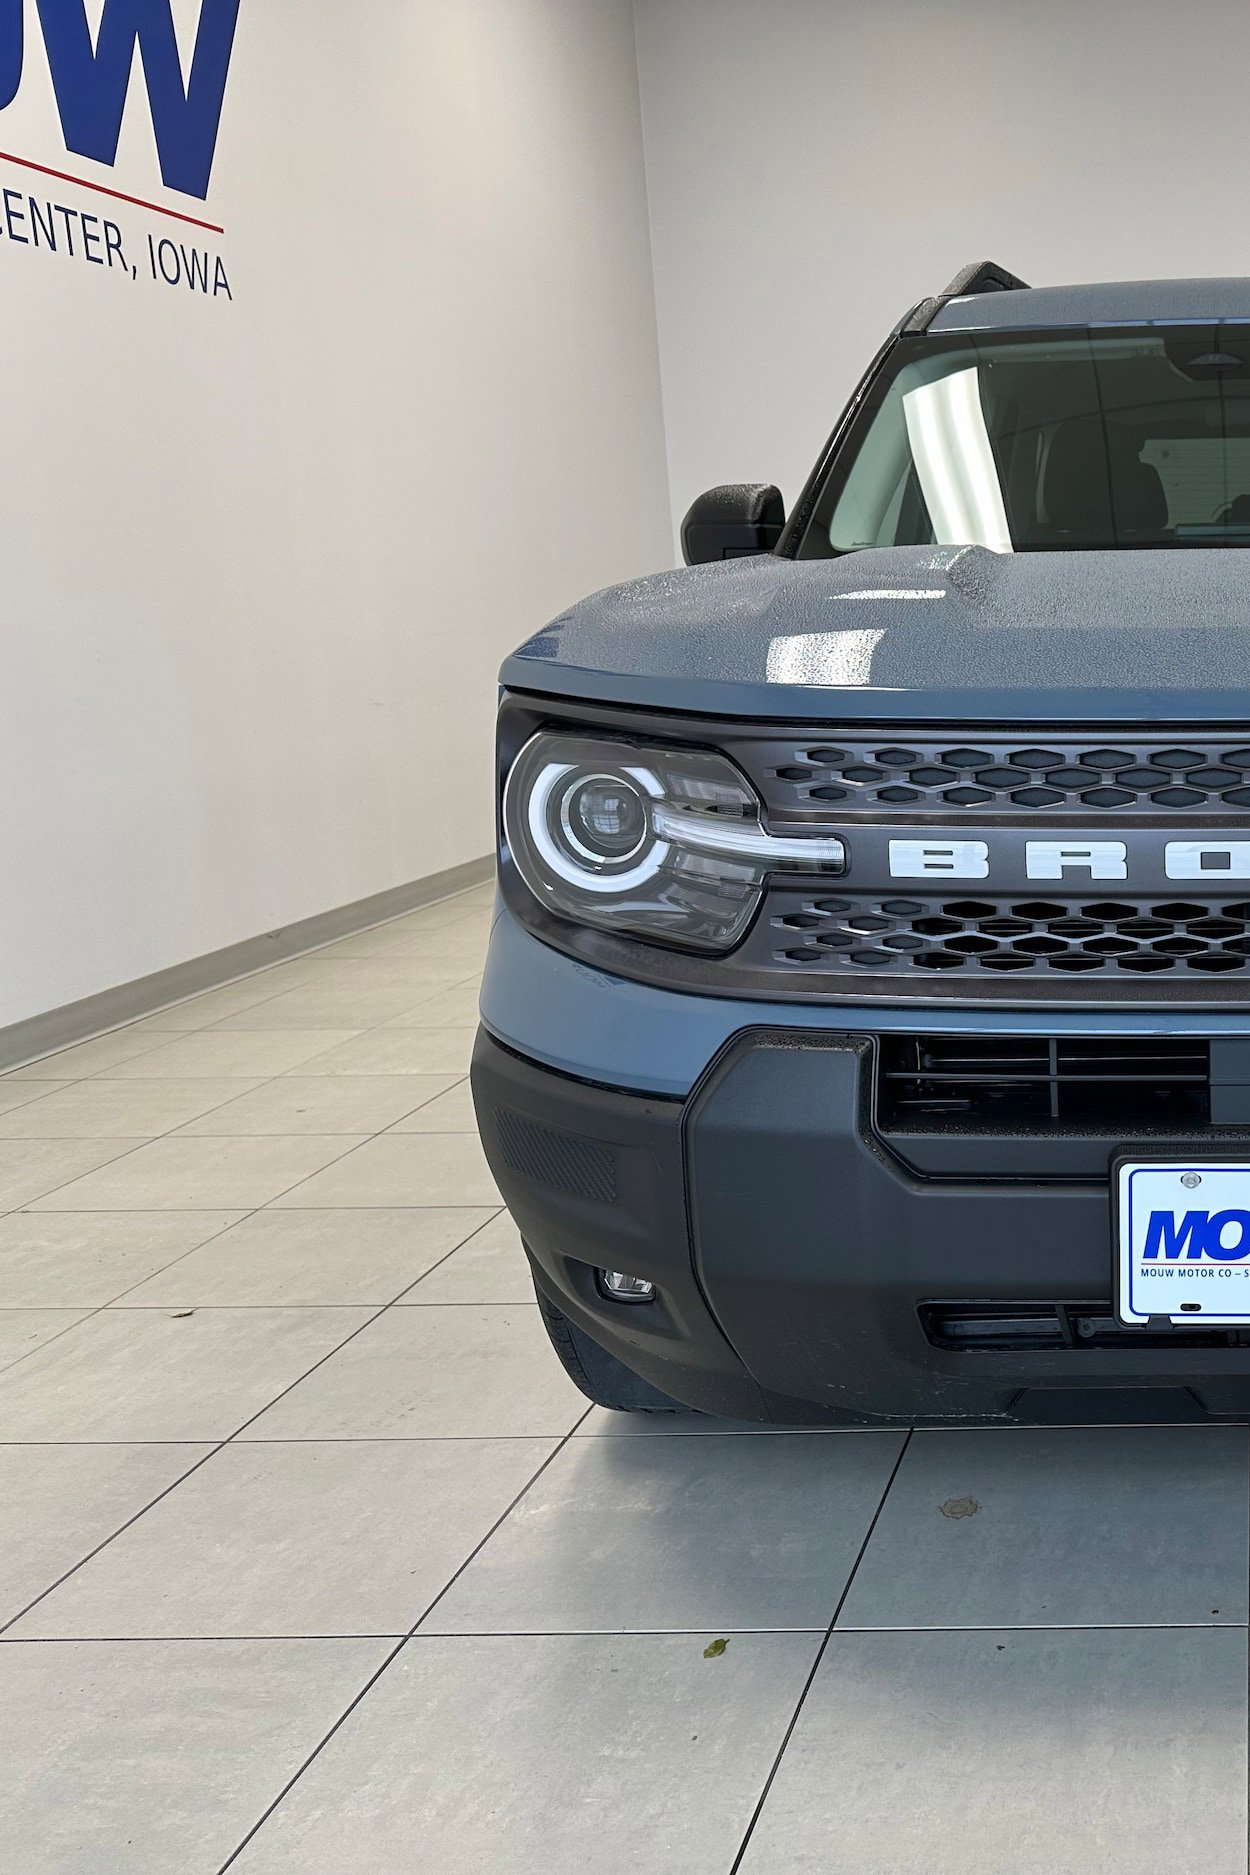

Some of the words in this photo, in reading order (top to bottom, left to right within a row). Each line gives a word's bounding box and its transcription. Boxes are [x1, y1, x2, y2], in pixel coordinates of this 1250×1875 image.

[0, 188, 137, 281] ENTER,
[148, 234, 233, 300] IOWA
[1140, 1268, 1174, 1278] MOUW
[1178, 1268, 1214, 1278] MOTOR
[1218, 1268, 1232, 1278] CO
